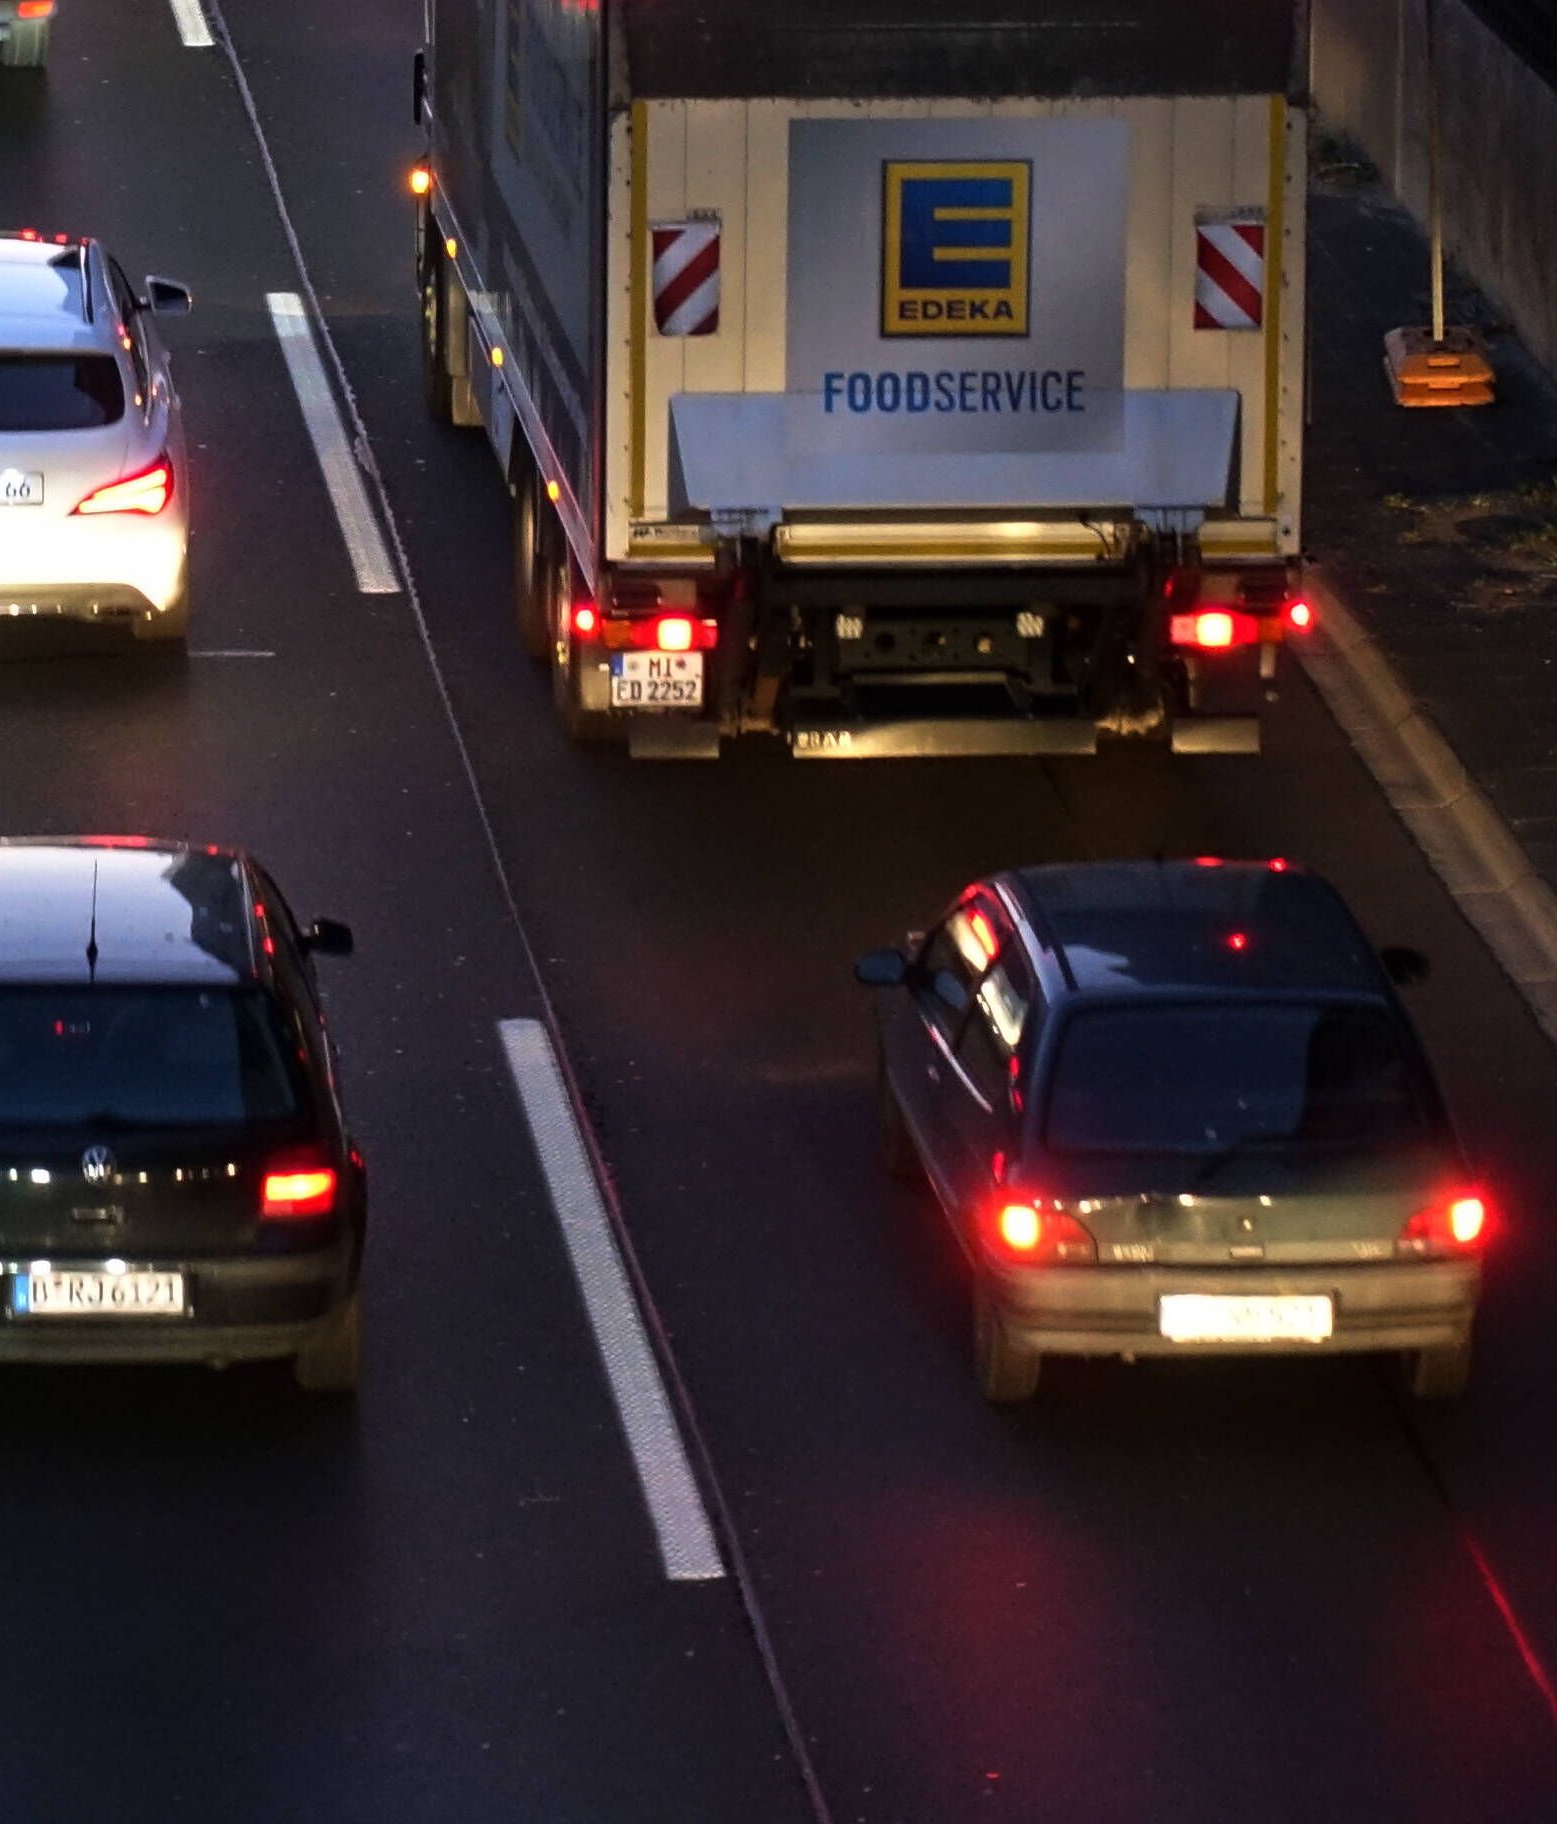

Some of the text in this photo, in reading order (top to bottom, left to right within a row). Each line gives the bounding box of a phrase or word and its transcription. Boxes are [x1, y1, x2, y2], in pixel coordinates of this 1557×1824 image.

[899, 299, 1014, 320] EDEKA
[823, 370, 1085, 413] FOODSERVICE
[648, 657, 673, 678] MI
[647, 679, 698, 702] 2252
